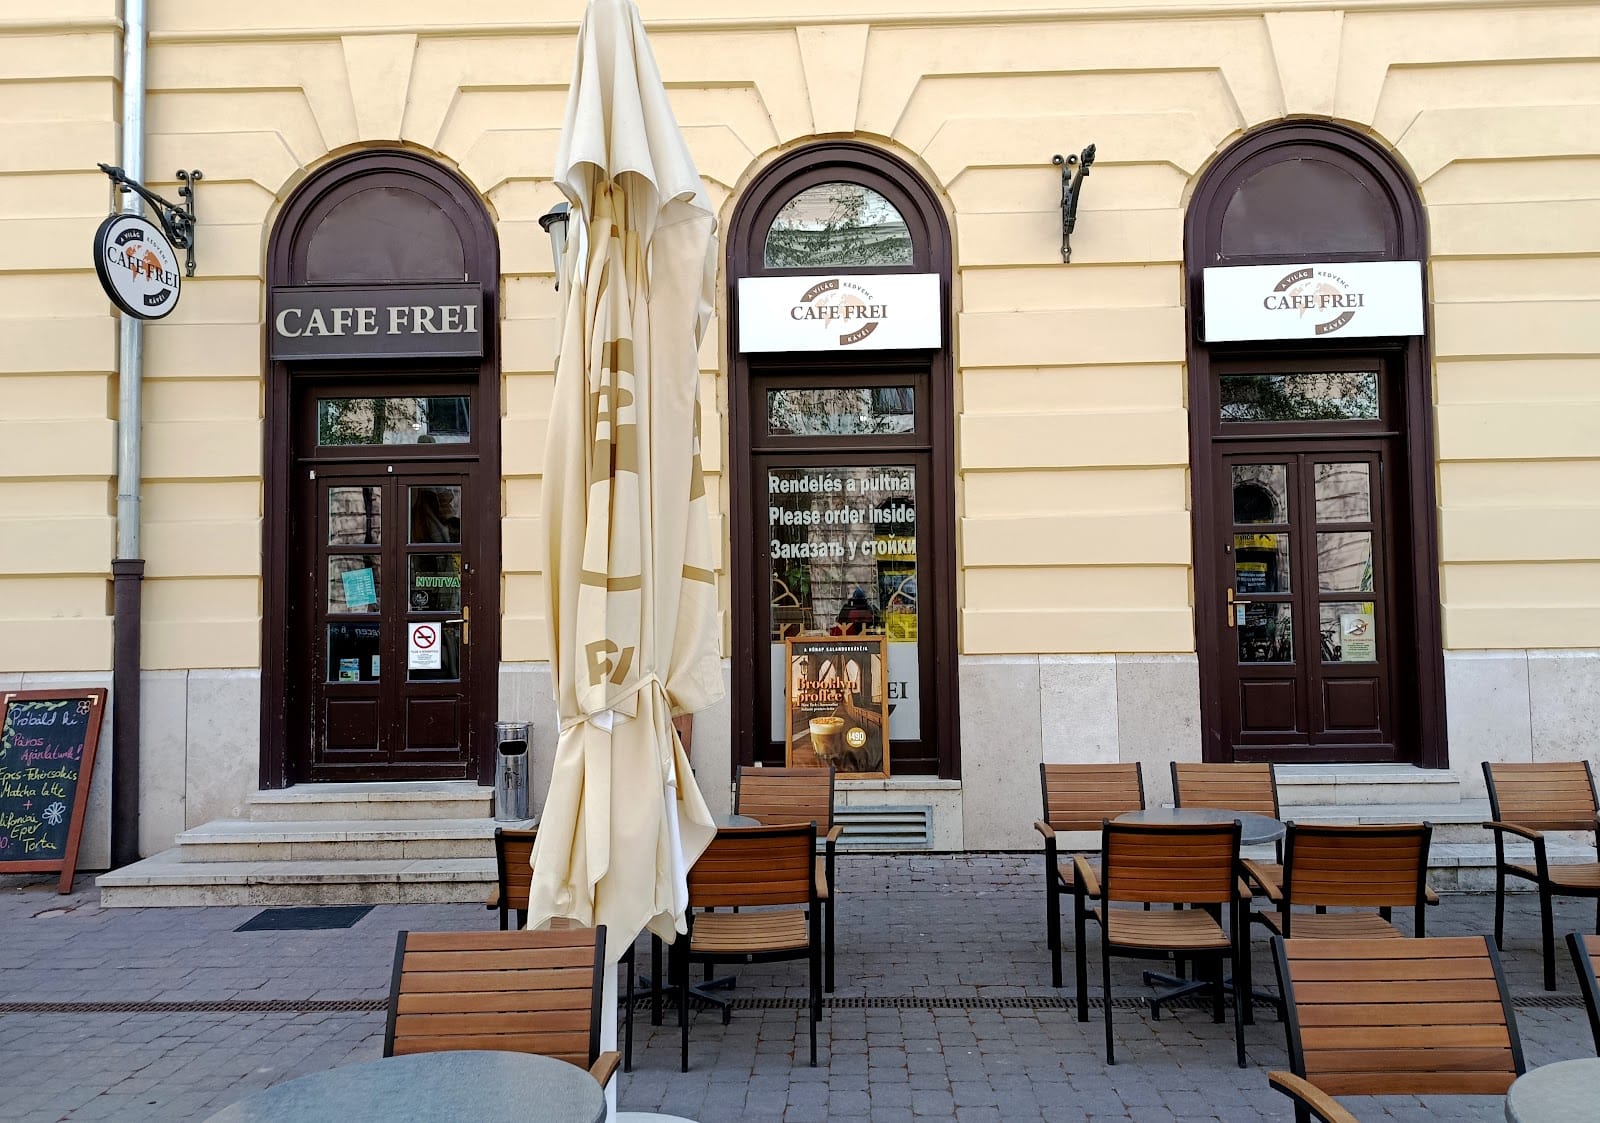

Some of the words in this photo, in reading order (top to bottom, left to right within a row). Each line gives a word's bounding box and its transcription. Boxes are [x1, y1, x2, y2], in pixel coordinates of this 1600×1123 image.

[107, 246, 144, 275] CAFE
[147, 263, 178, 288] FREI
[1287, 271, 1308, 283] VILÁG
[1317, 271, 1349, 289] KEDVENC
[813, 282, 834, 294] VILÁG
[843, 282, 873, 300] KEDVENC
[1263, 295, 1315, 311] CAFE
[1320, 293, 1365, 309] FREI
[276, 307, 379, 338] CAFE
[386, 304, 478, 335] FREI
[790, 305, 840, 321] CAFE
[844, 304, 888, 319] FREI
[769, 473, 842, 494] Rendelés
[846, 480, 856, 492] a
[860, 472, 915, 495] pultnál
[769, 506, 821, 526] Please
[825, 504, 865, 524] order
[869, 503, 915, 524] inside
[770, 538, 845, 559] Заказать
[848, 541, 857, 560] у
[861, 533, 916, 555] стойки
[415, 576, 461, 588] NYITVA
[797, 676, 857, 691] Brooklyn
[887, 681, 909, 699] EI
[1, 781, 37, 798] Matcha
[41, 782, 67, 798] latte
[10, 822, 43, 841] Eper
[22, 832, 57, 854] Torta
